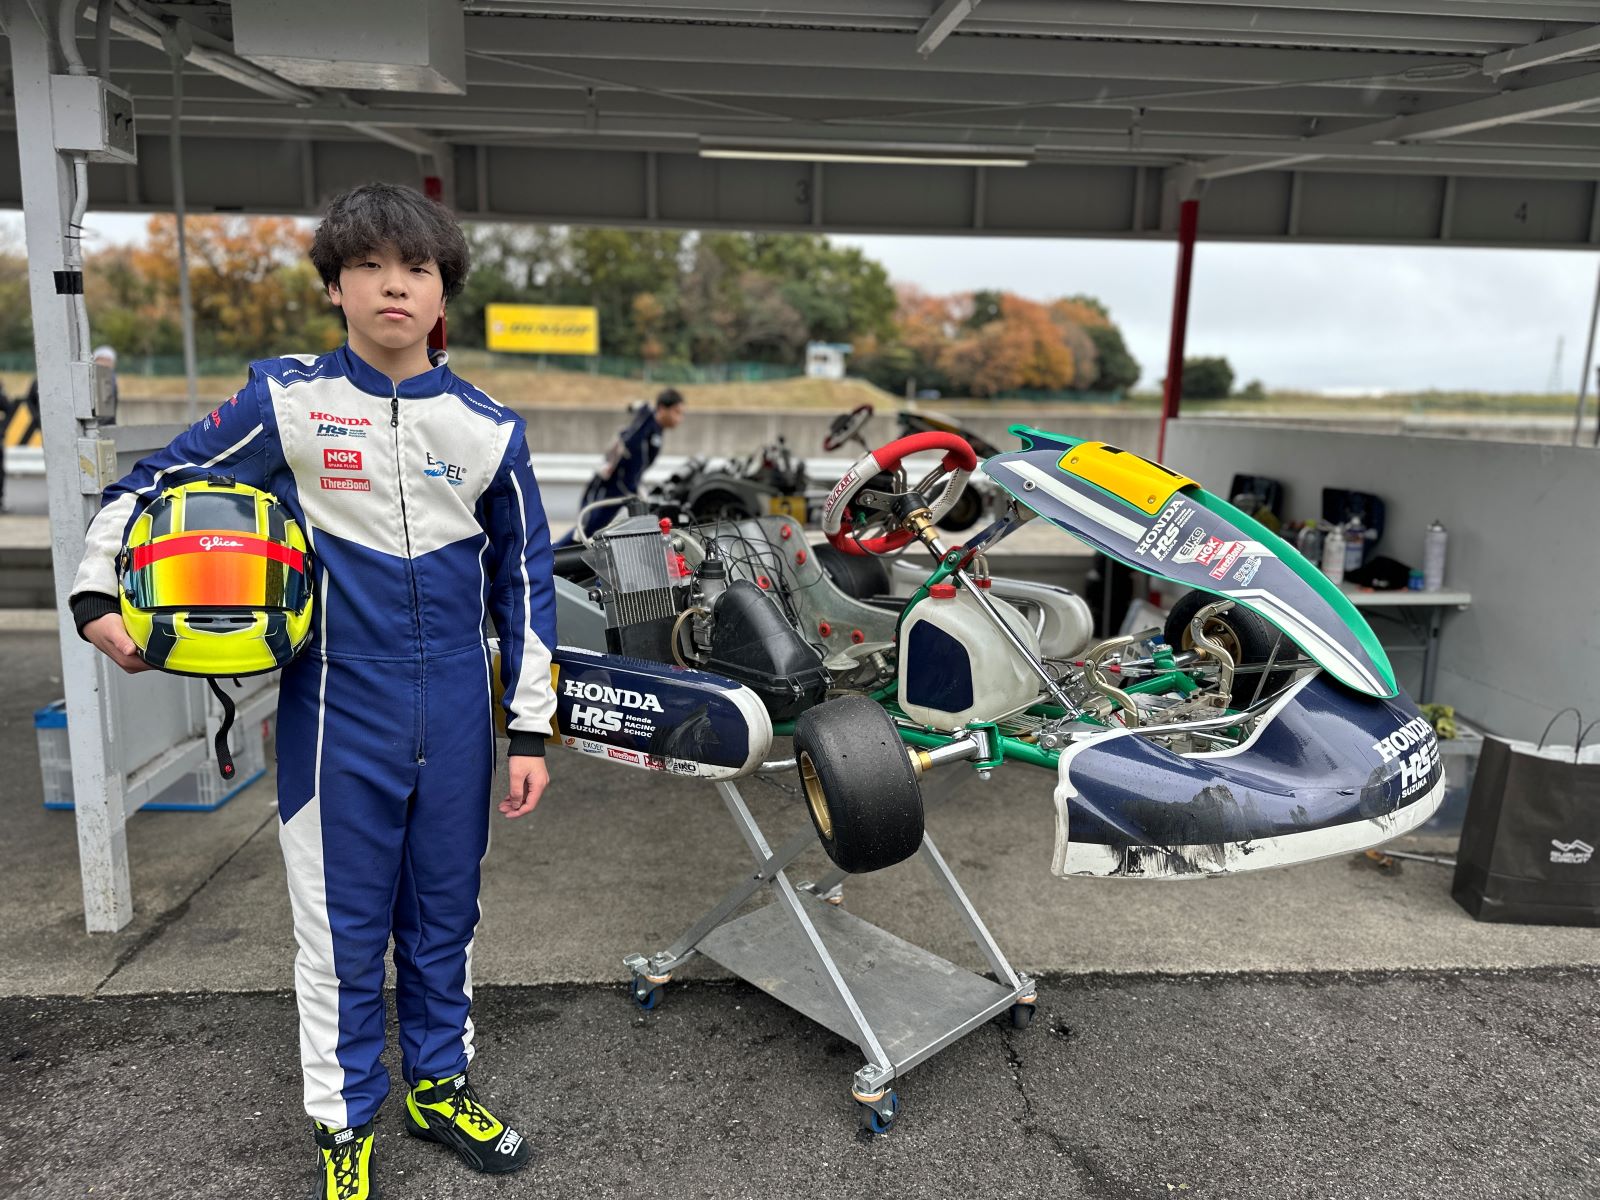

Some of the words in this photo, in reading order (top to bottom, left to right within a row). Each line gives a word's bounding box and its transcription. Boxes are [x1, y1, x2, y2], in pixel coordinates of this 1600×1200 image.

[309, 411, 372, 426] HONDA
[317, 423, 348, 436] HRS
[327, 451, 358, 463] NGK
[321, 478, 369, 490] ThreeBond
[1135, 500, 1185, 556] HONDA
[199, 536, 243, 551] Glico
[1150, 522, 1180, 561] HRS
[1180, 528, 1203, 556] EIKO
[1196, 538, 1220, 562] NGK
[1211, 542, 1244, 577] ThreeBond
[564, 679, 664, 713] HONDA
[571, 703, 623, 732] HRS
[625, 714, 652, 724] Honda
[570, 723, 608, 737] SUZUKA
[1372, 716, 1433, 763] HONDA
[1401, 777, 1428, 799] SUZUKA
[455, 1075, 466, 1087] OMP
[335, 1130, 353, 1142] OMP
[500, 1129, 521, 1154] OMP
